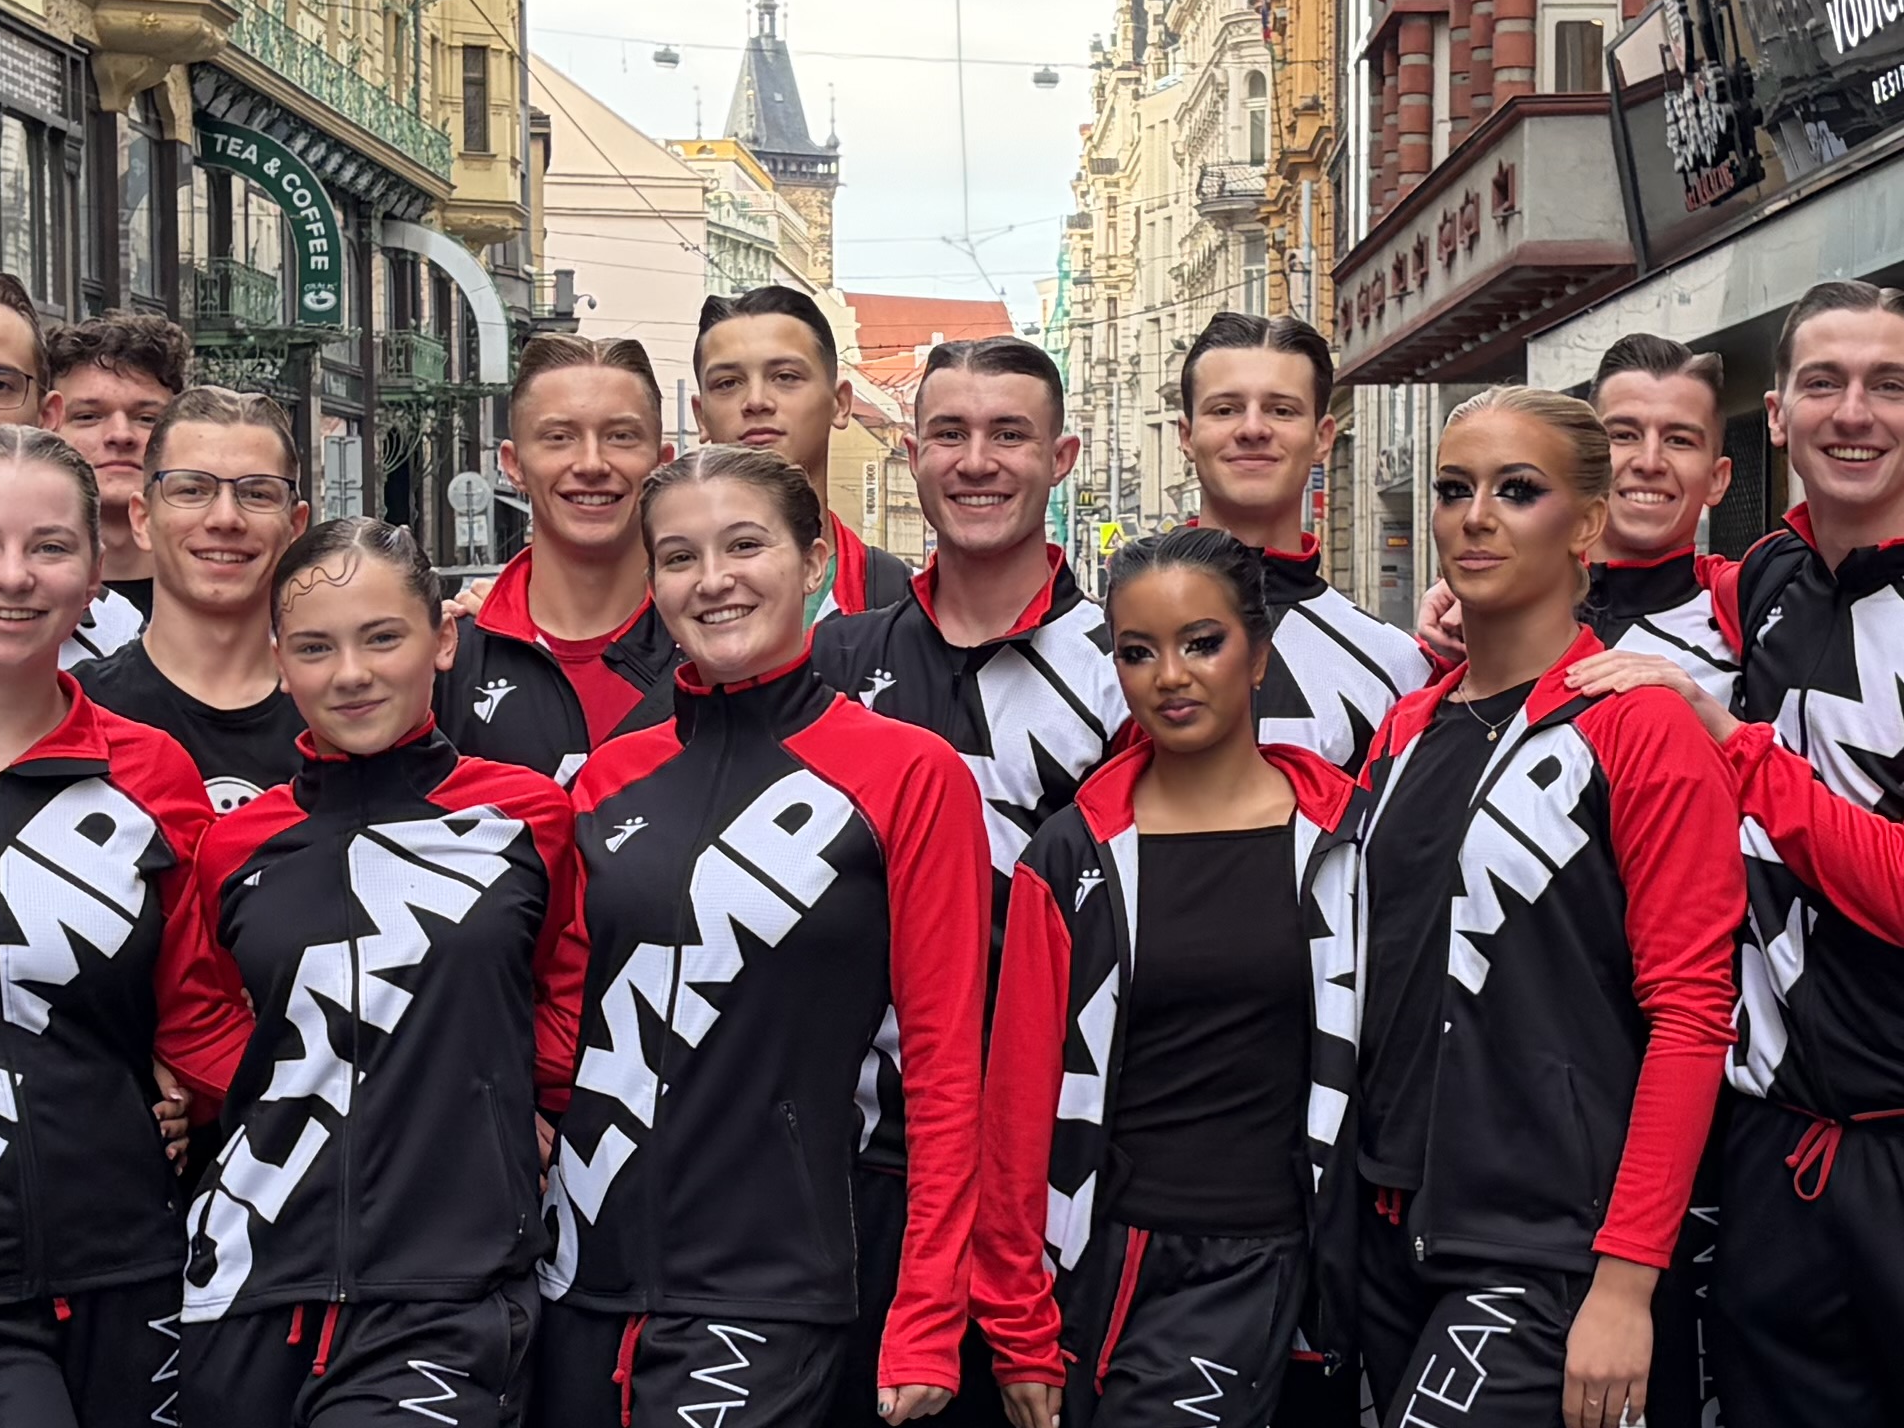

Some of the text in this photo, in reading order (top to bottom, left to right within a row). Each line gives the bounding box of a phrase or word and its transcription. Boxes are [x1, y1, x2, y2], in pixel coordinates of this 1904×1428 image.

[214, 133, 330, 271] TEA & COFFEE
